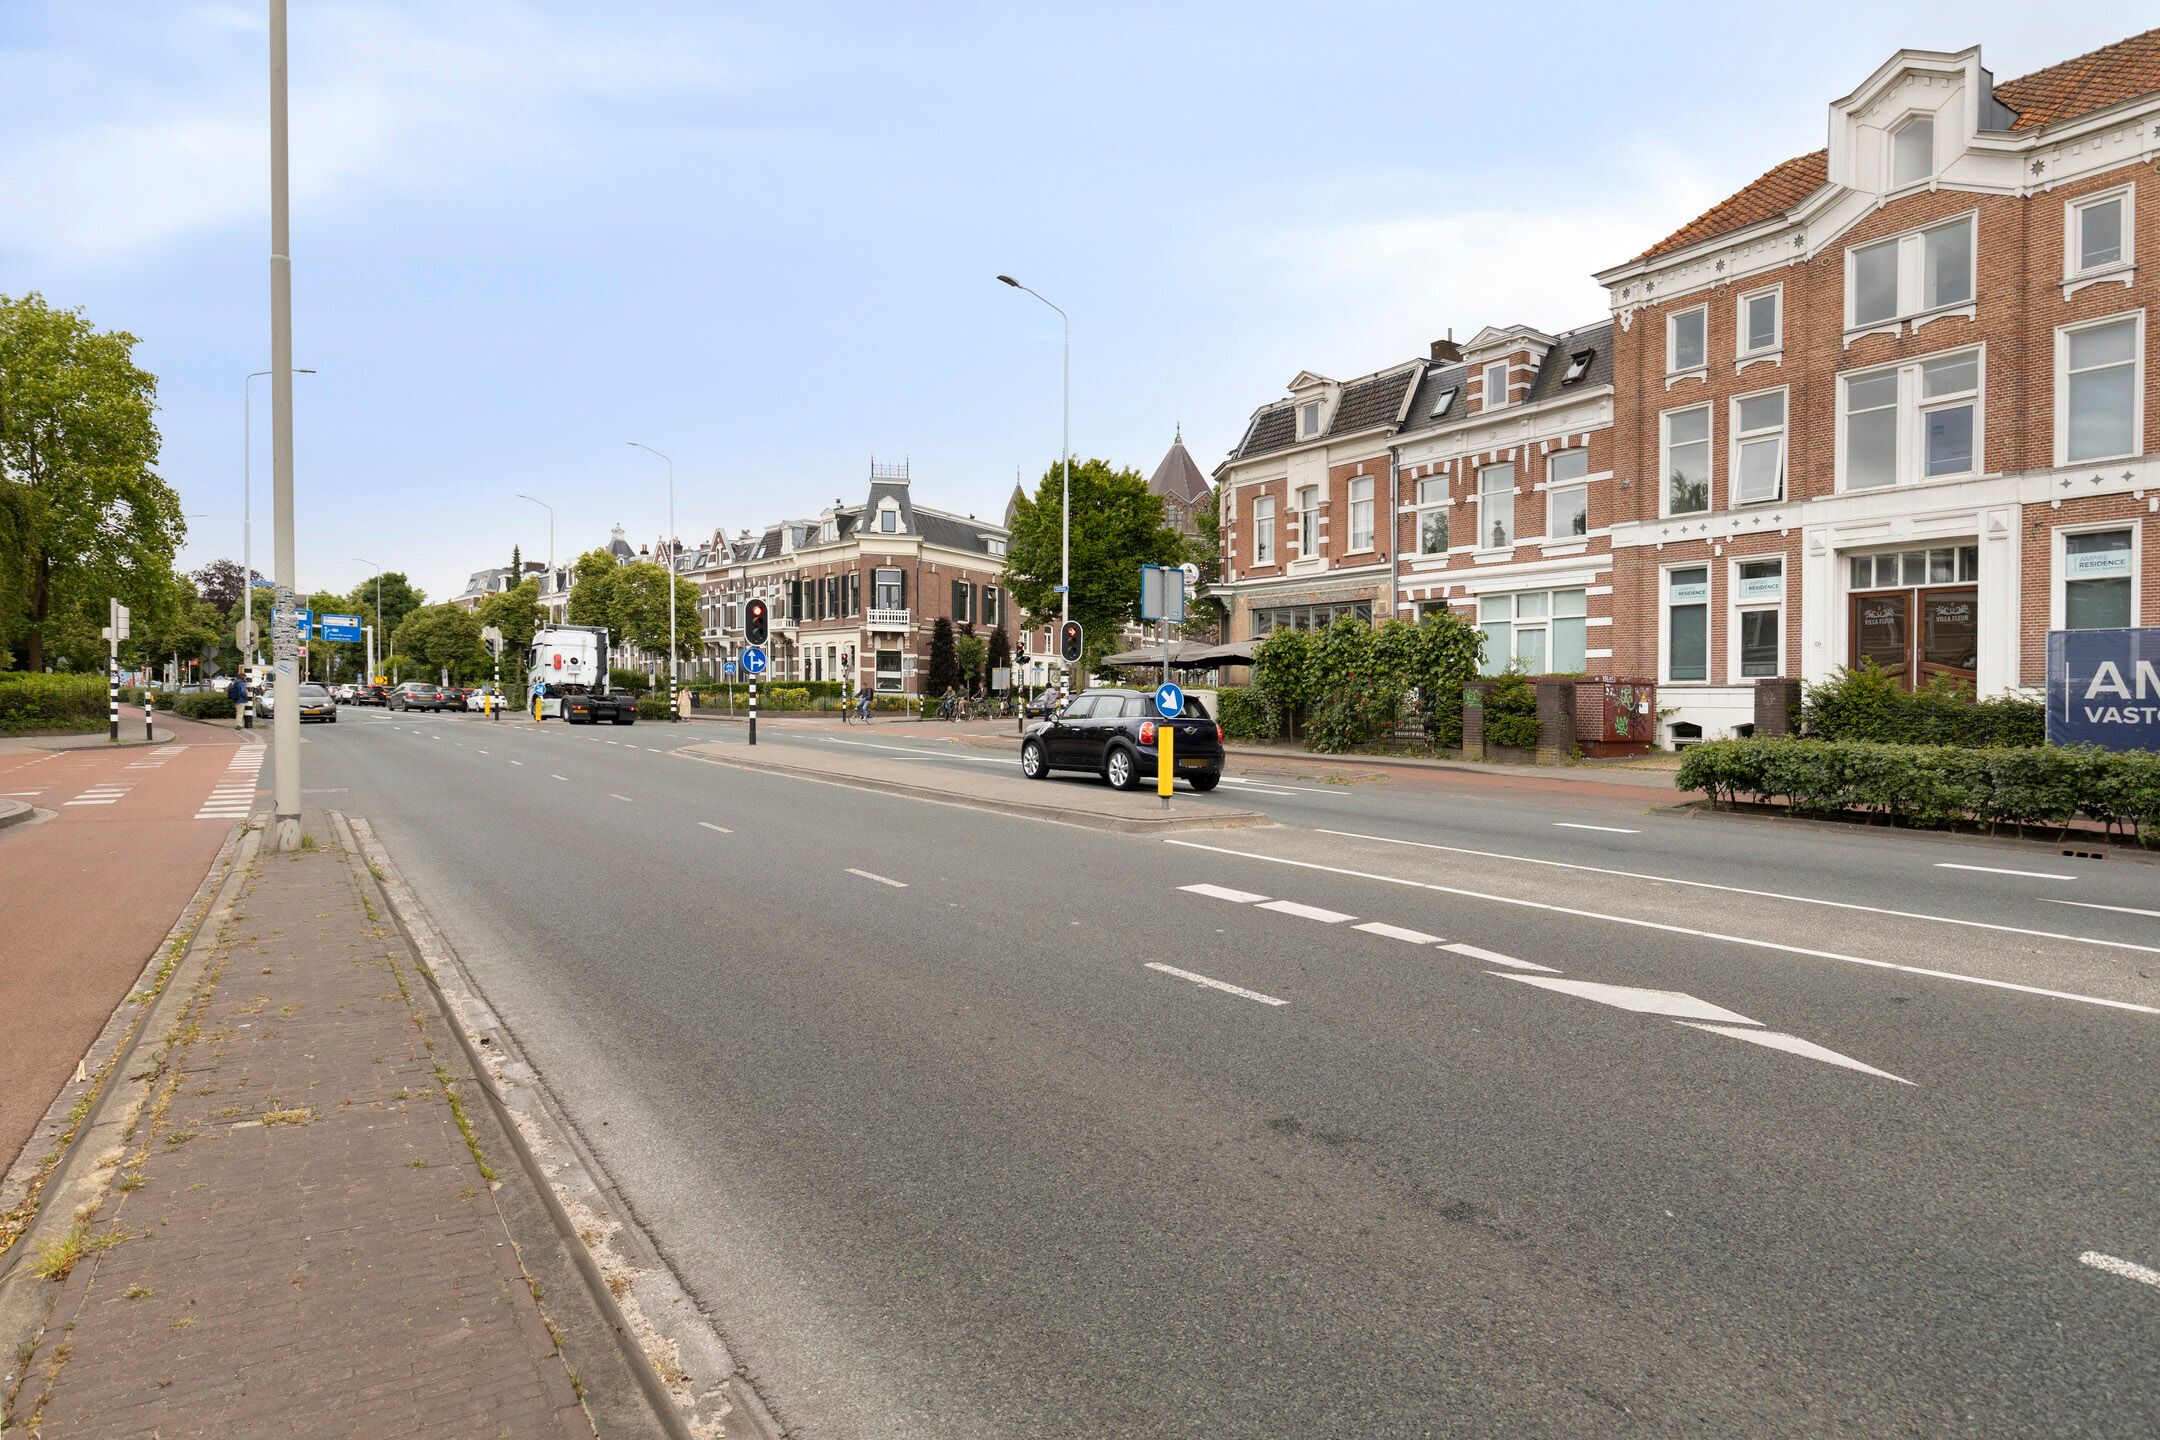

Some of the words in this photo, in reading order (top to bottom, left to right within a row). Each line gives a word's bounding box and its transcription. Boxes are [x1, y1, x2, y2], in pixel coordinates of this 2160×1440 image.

[2079, 559, 2125, 568] RESIDENCE
[1951, 614, 1969, 622] FLEUR
[2084, 706, 2160, 724] VAST
